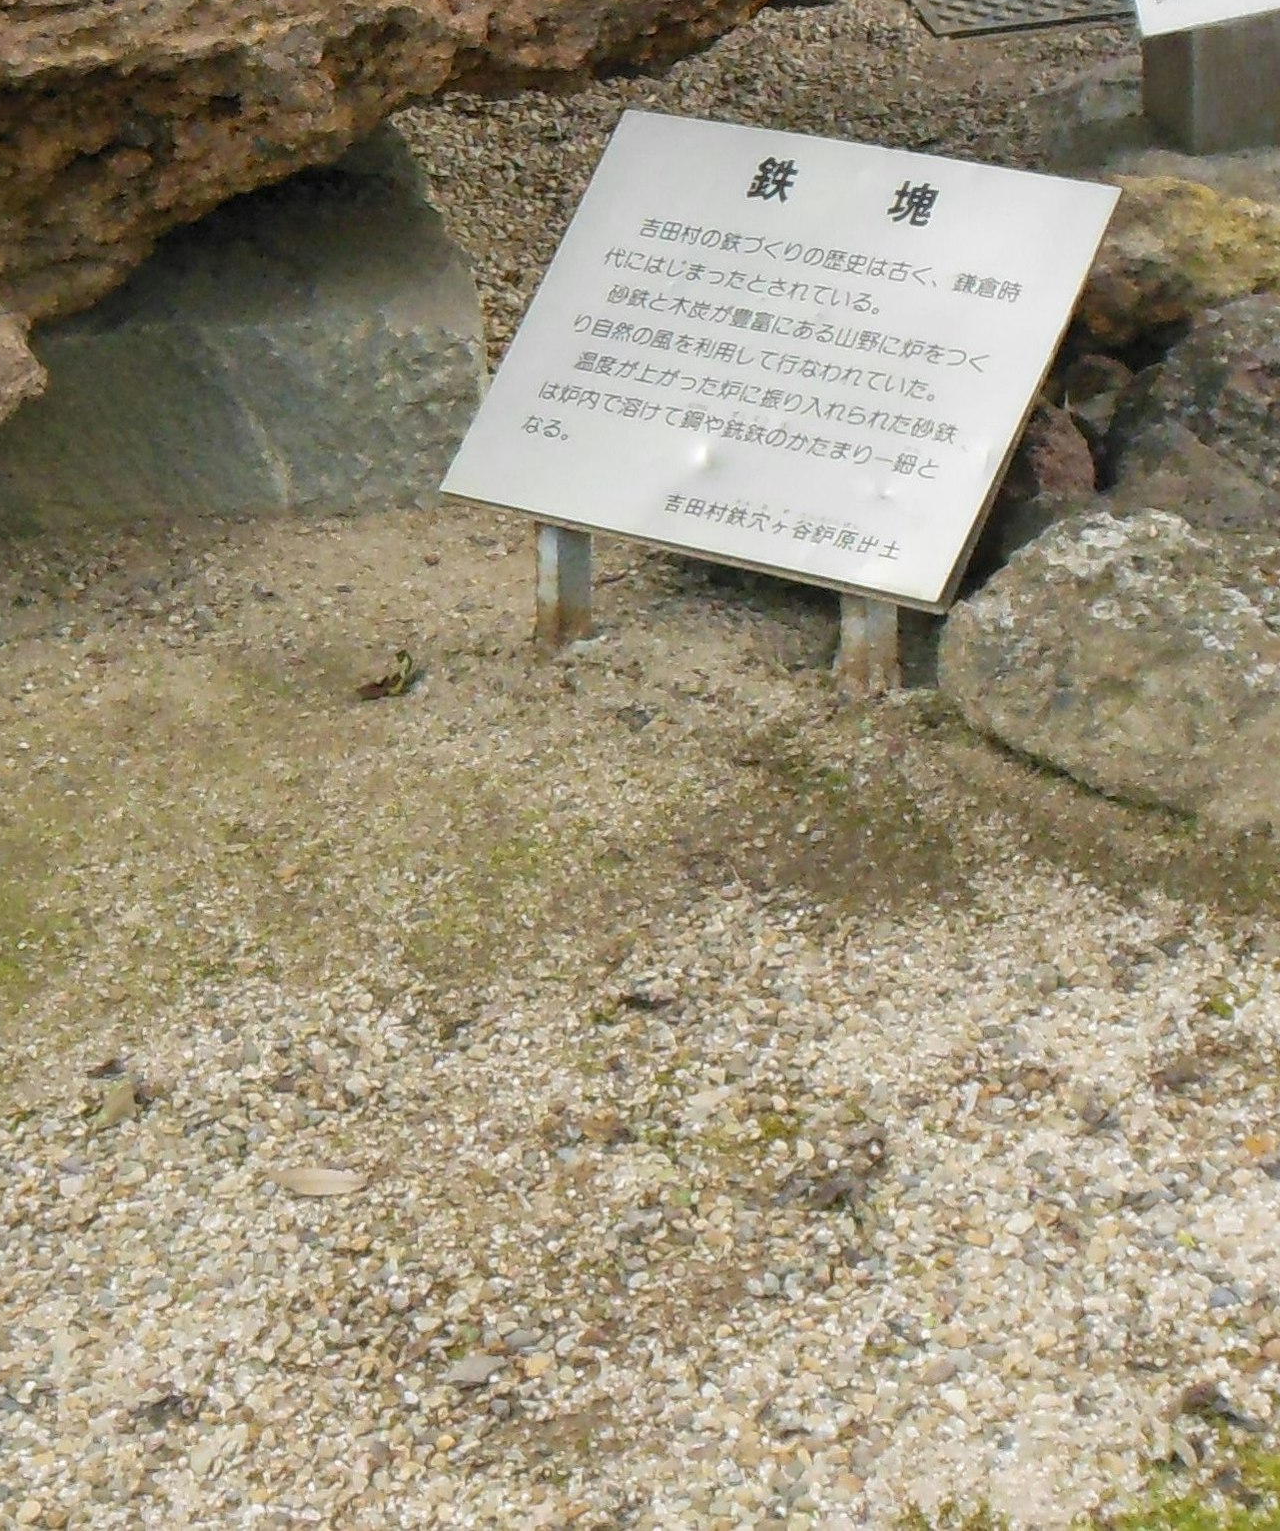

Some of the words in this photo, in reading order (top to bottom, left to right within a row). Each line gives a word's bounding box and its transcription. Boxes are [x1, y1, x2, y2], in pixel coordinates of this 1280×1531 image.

[745, 155, 799, 204] 鉄
[885, 179, 940, 227] 塊
[602, 246, 880, 315] 代にはじまったとされている。
[638, 217, 1022, 303] 吉田村の鉄づくりの歴史は古く、鎌倉時
[572, 313, 935, 402] り自然の風を利用して行なわれていた。
[606, 283, 990, 373] 砂鉄と木炭が豊富にある山野に炉をつく
[519, 413, 570, 442] なる。
[572, 350, 958, 445] 温度が上がった炉に振り入れられた砂鉄
